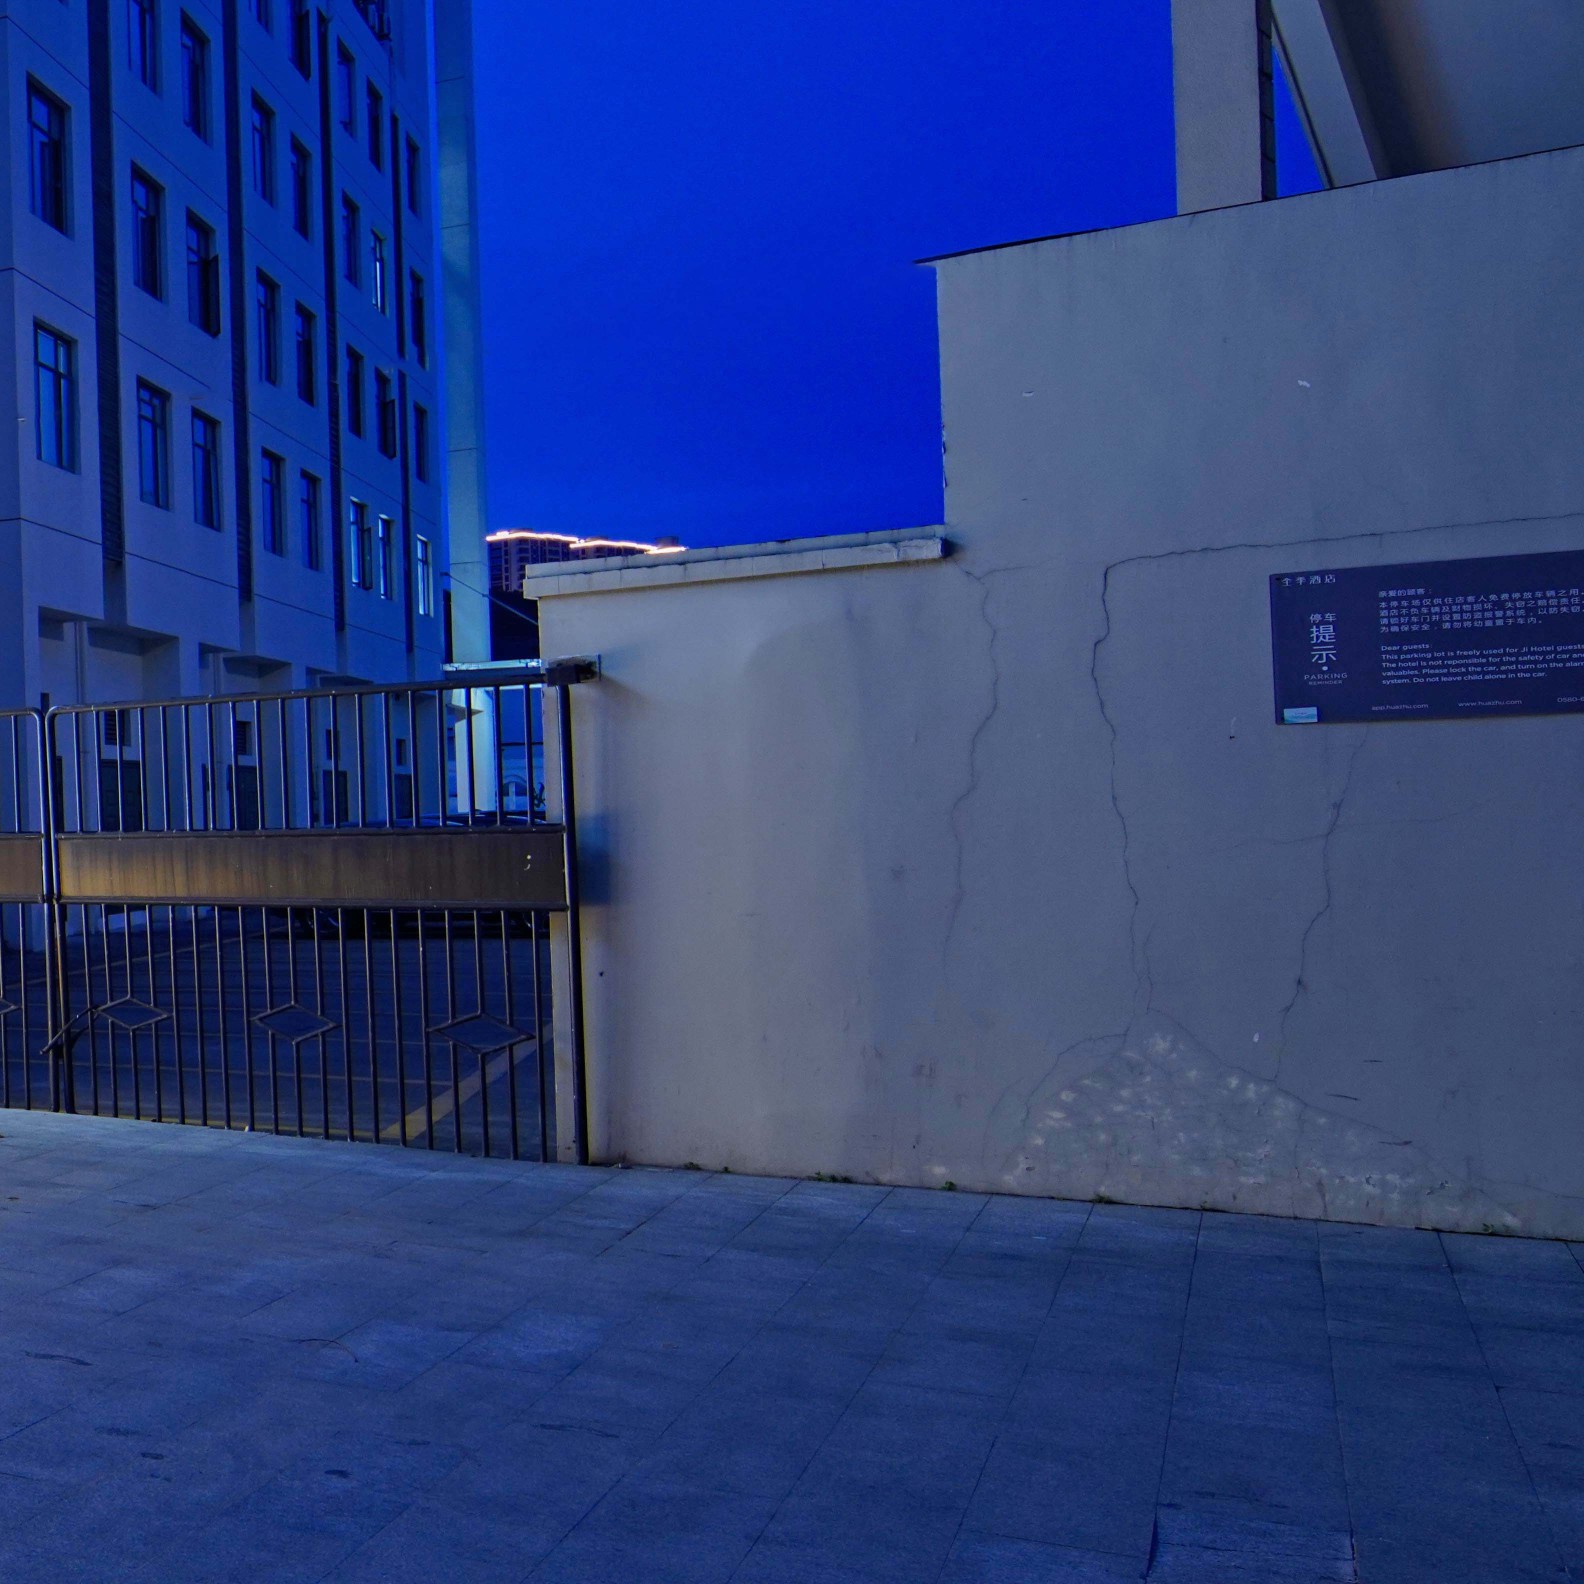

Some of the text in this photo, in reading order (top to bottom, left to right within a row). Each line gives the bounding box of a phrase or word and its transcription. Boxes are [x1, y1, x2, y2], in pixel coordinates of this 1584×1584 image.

[1281, 573, 1336, 587] 全季酒店
[1309, 612, 1337, 624] 停车
[1309, 624, 1337, 664] 提示
[1400, 652, 1432, 660] parking
[1304, 671, 1348, 680] PARKING
